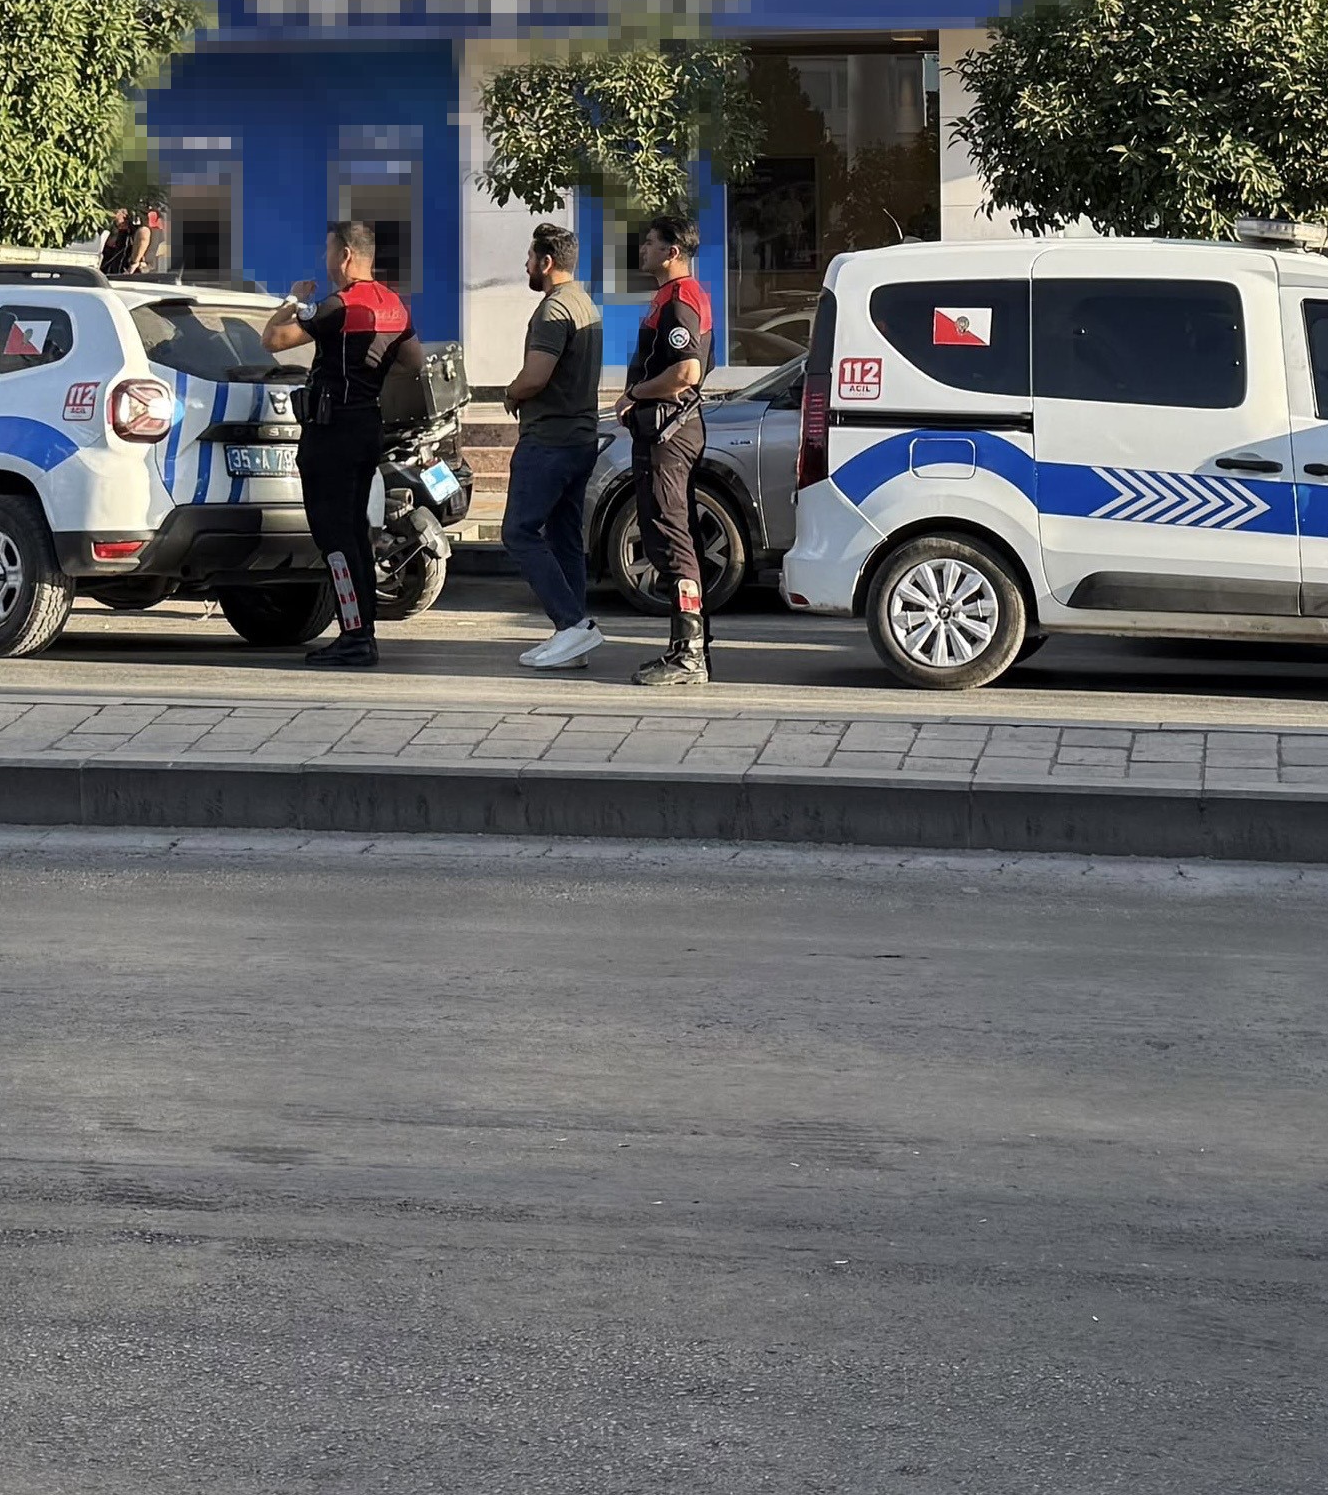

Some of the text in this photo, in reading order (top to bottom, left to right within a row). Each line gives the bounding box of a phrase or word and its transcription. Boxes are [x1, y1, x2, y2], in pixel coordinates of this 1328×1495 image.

[842, 361, 879, 383] 112
[68, 386, 96, 405] 112
[231, 449, 251, 469] 35
[262, 448, 271, 467] A
